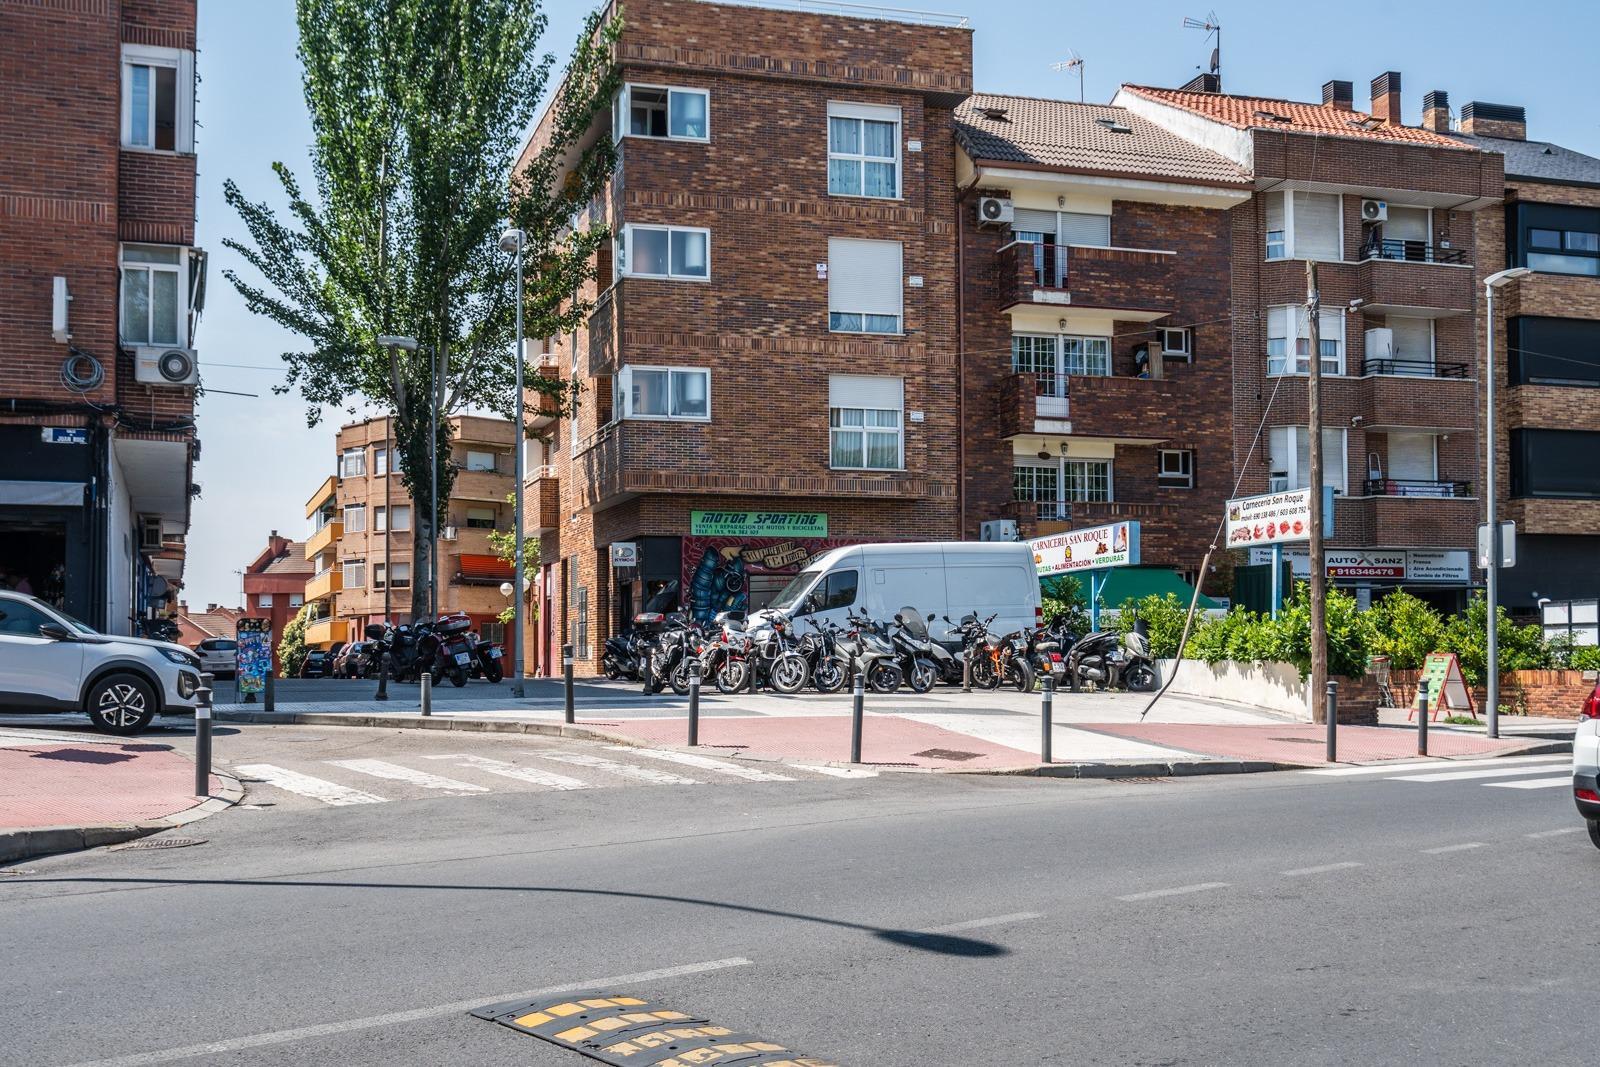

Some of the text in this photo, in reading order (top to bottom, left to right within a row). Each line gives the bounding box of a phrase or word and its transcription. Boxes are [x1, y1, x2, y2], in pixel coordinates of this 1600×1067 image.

[1272, 496, 1283, 506] San
[1284, 494, 1304, 505] Roque
[701, 512, 818, 525] MOTOR SPORTING
[1070, 534, 1082, 546] SAN
[1084, 528, 1108, 542] ROQUE
[1095, 554, 1124, 564] VERDURAS
